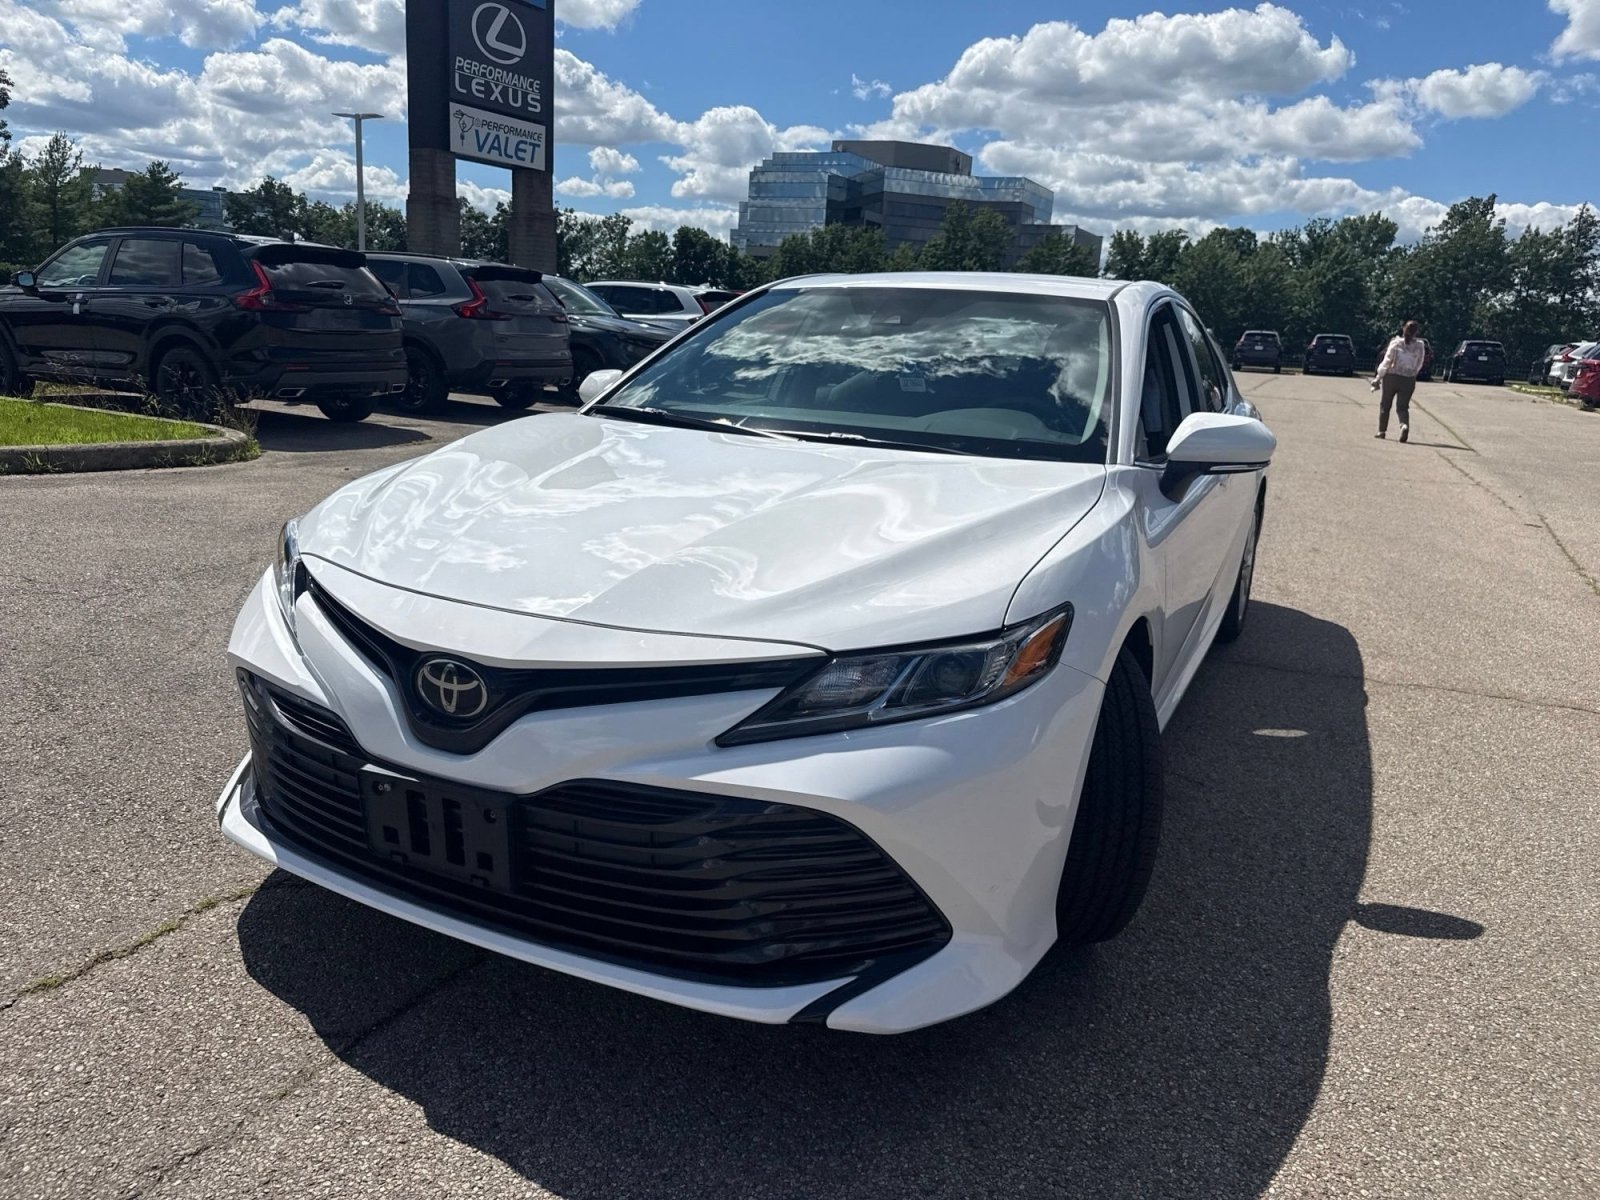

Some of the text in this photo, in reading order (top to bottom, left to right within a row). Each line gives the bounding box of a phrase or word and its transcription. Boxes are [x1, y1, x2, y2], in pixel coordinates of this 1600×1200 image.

[454, 71, 542, 113] LEXUS
[455, 55, 541, 93] PERFORMANCE
[474, 128, 541, 164] VALET
[481, 119, 543, 143] PERFORMANCE
